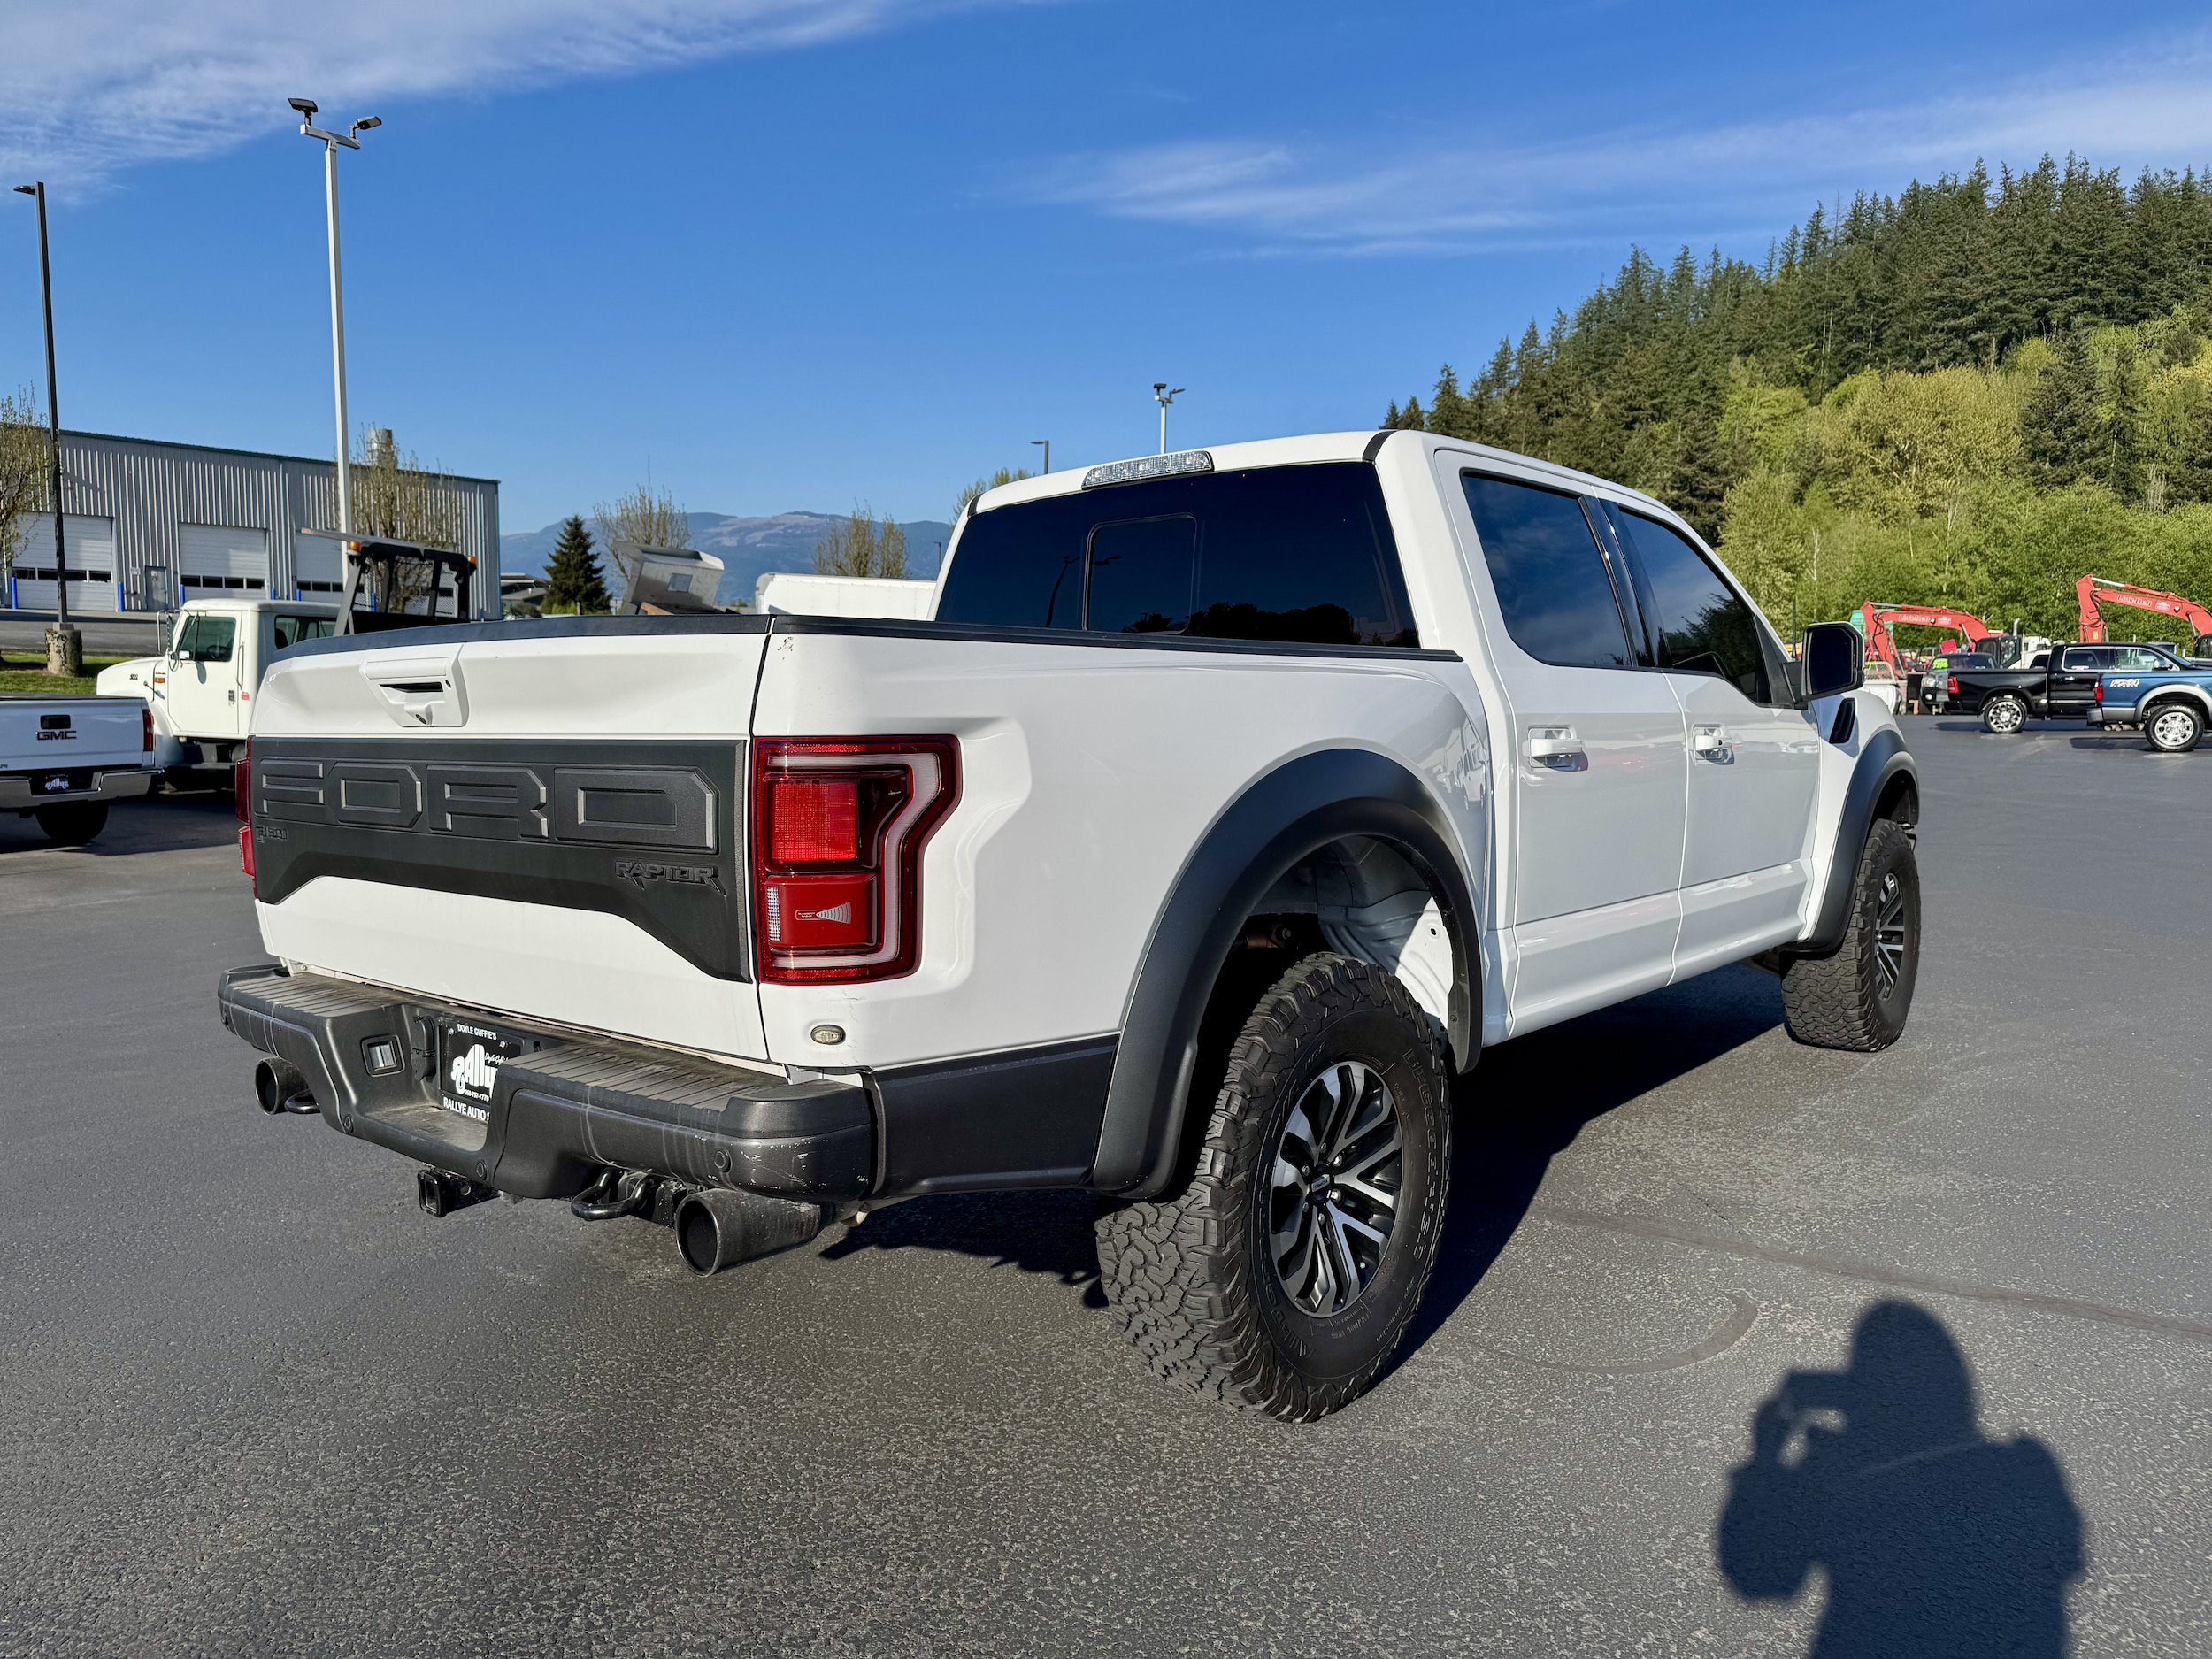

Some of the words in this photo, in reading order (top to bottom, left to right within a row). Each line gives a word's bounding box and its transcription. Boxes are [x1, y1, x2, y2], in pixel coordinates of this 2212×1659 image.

[36, 730, 77, 741] GMC
[255, 757, 719, 855] FORD
[615, 860, 727, 897] RAPTOR
[457, 1023, 474, 1036] DOYLE
[473, 1027, 497, 1041] GUFFIE'S
[443, 1096, 467, 1116] RALLYE
[466, 1105, 487, 1122] AUTO
